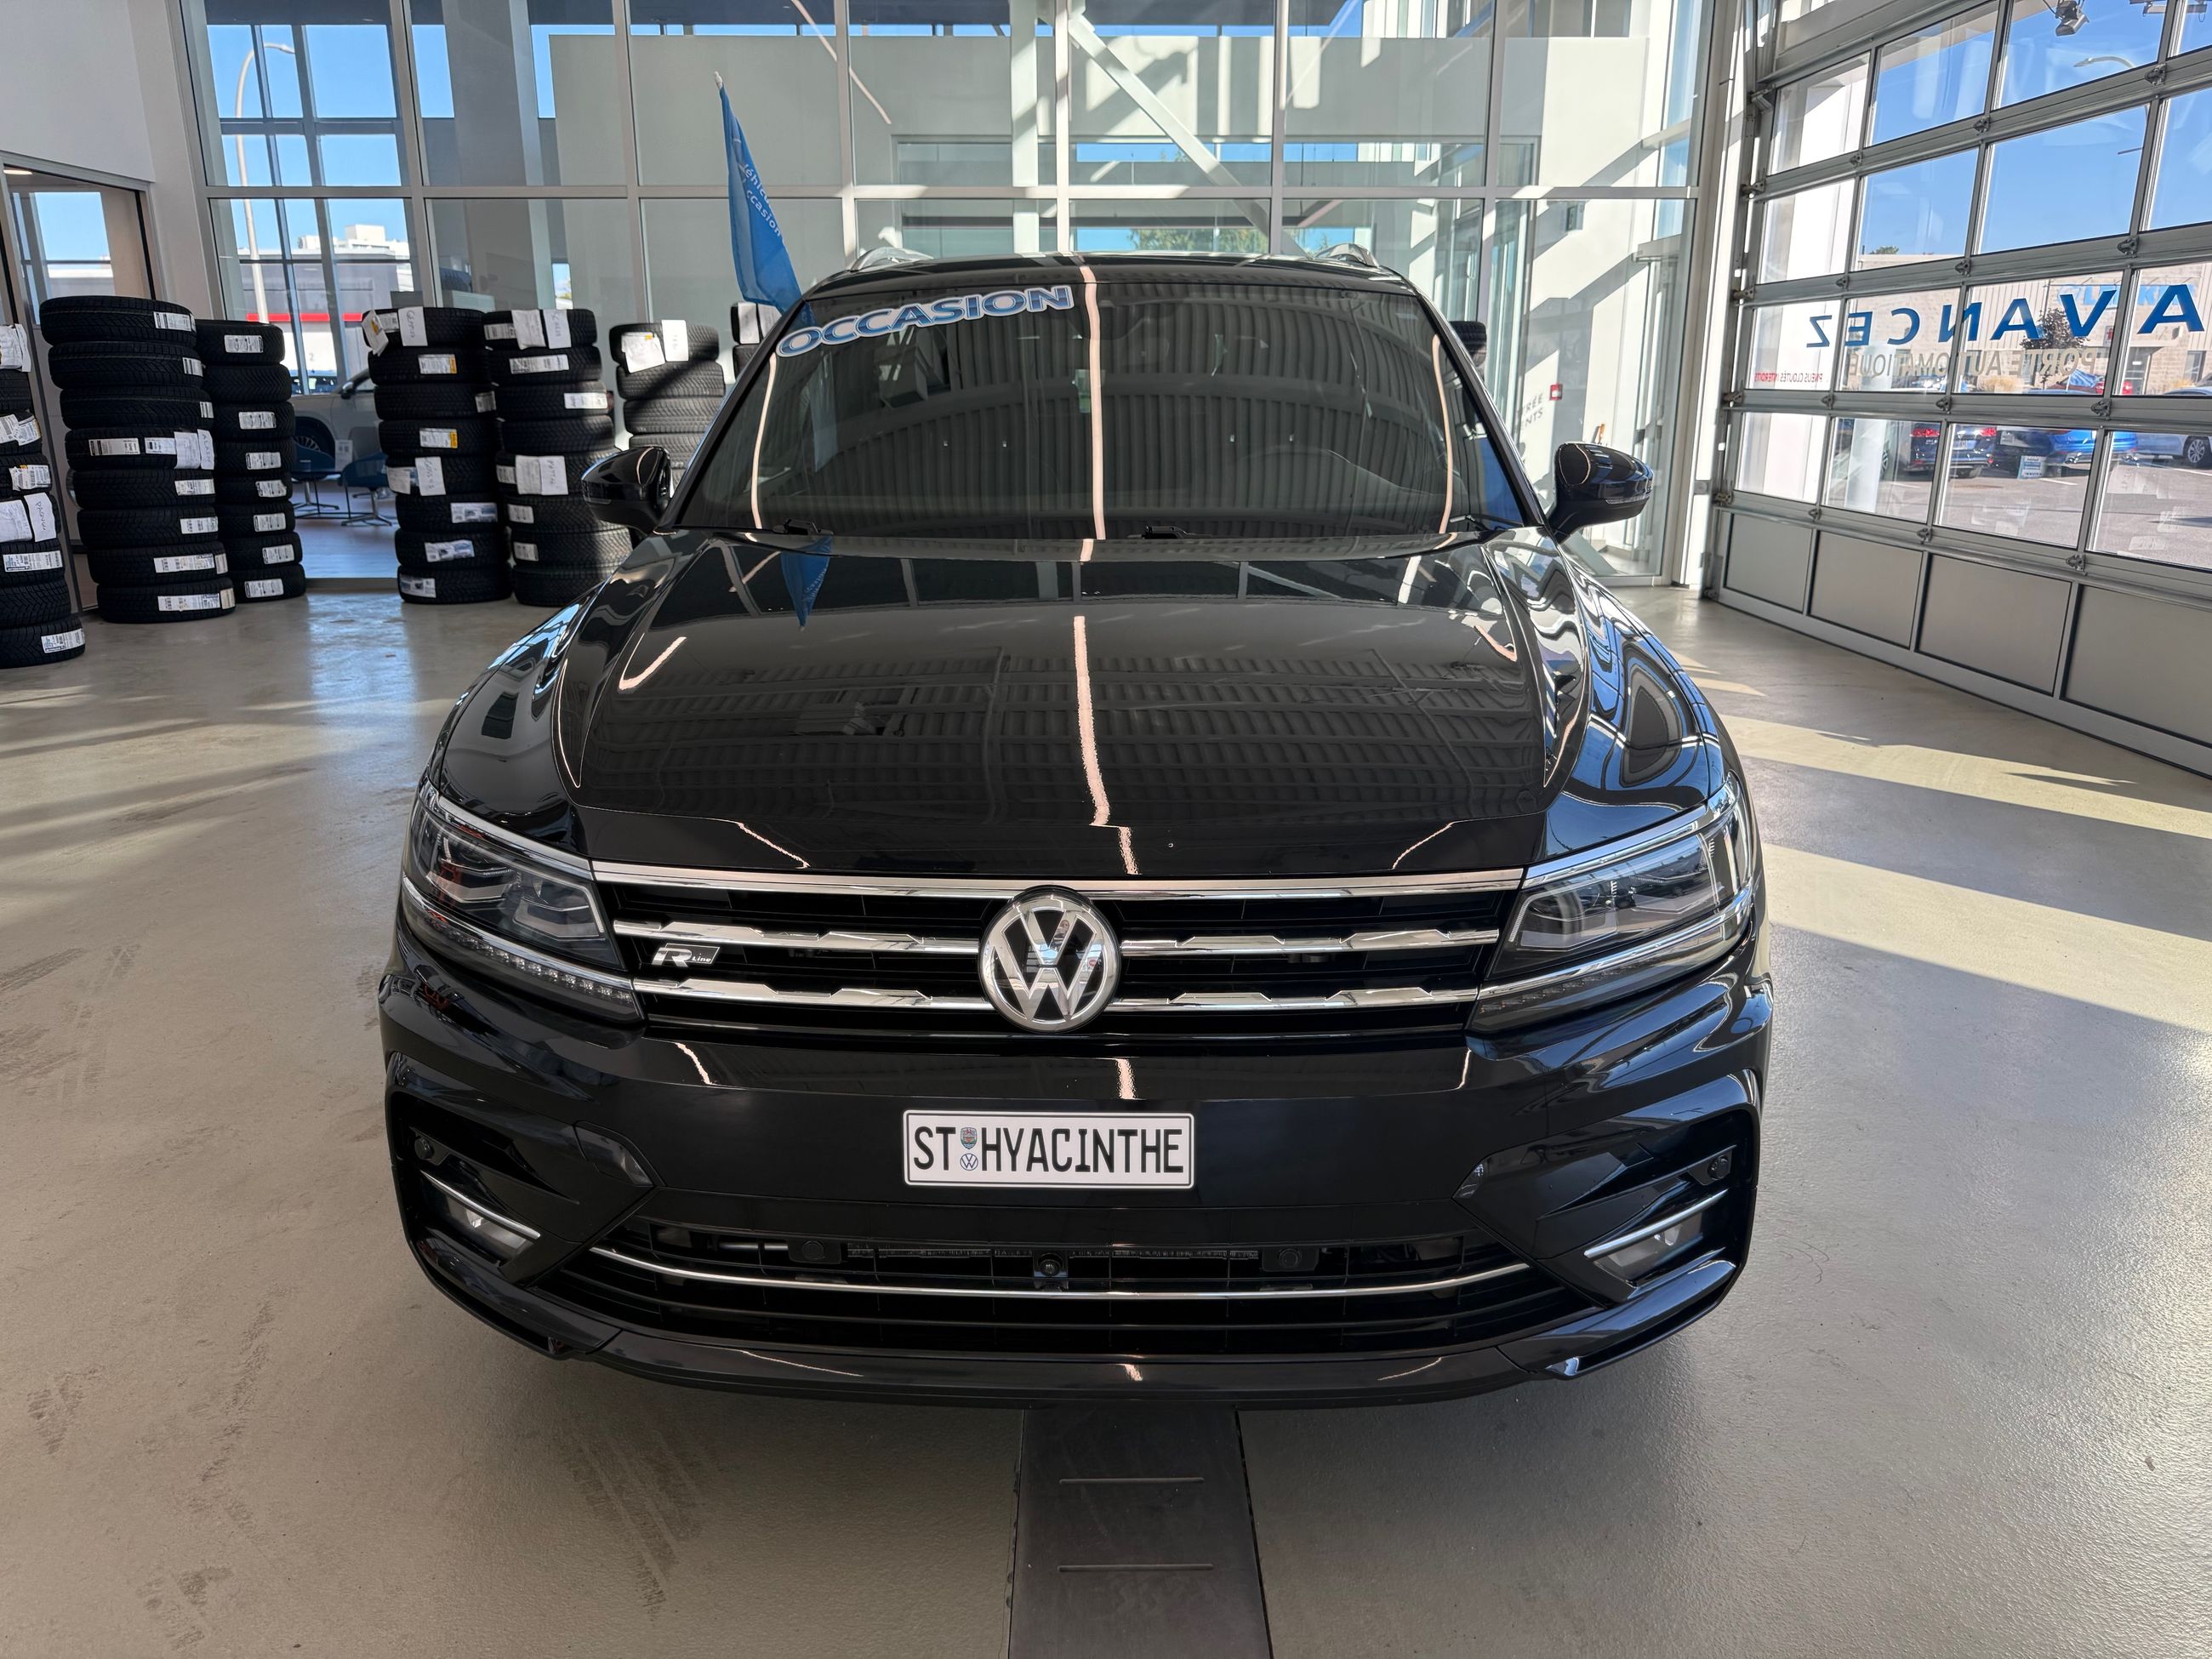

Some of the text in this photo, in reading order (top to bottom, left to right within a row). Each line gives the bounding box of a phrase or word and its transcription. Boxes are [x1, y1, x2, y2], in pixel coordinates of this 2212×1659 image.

[776, 285, 1075, 356] OCCASION
[652, 947, 712, 967] R Line
[913, 1126, 1184, 1173] ST HYACINTHE
